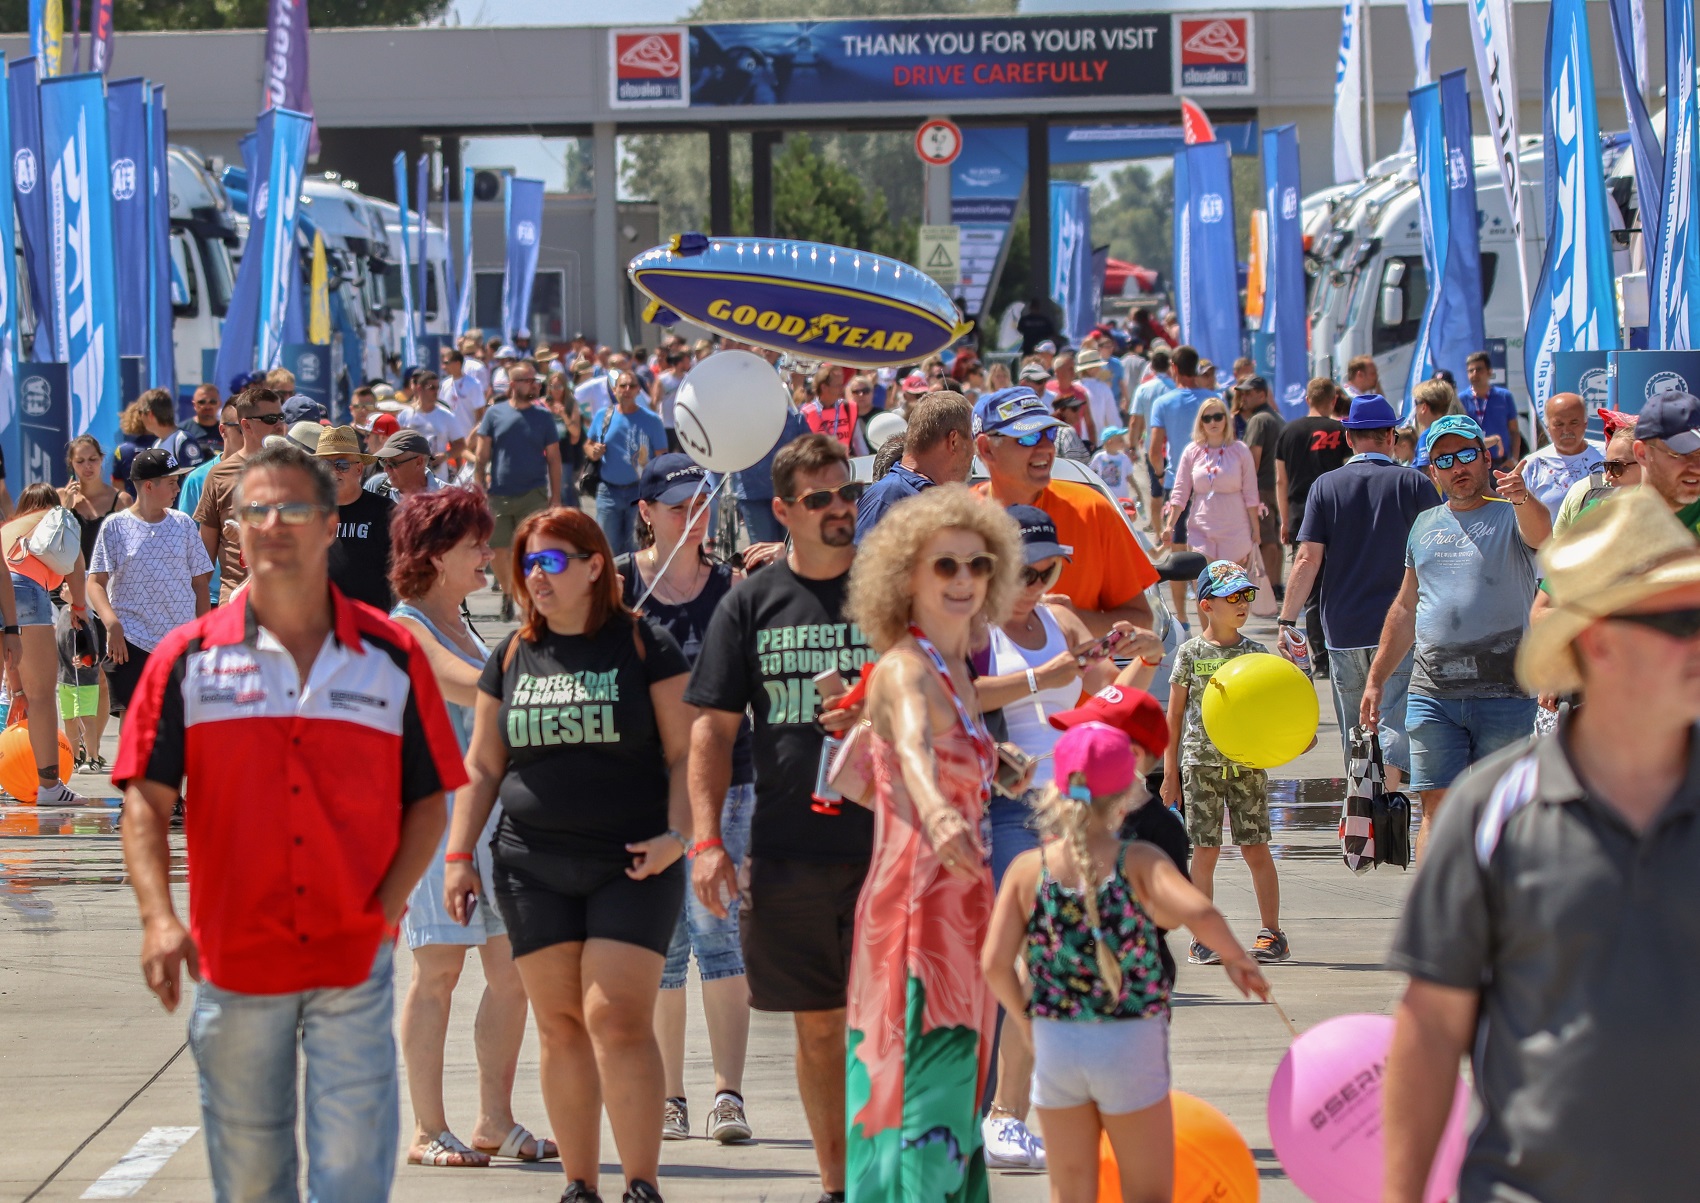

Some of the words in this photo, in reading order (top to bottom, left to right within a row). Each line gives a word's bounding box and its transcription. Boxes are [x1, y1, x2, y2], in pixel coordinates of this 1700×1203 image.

[842, 33, 921, 56] THANK
[924, 32, 974, 55] YOU
[981, 31, 1025, 53] FOR
[1030, 29, 1096, 52] YOUR
[1101, 28, 1157, 51] VISIT
[893, 65, 964, 87] DRIVE
[972, 61, 1108, 84] CAREFULLY
[27, 380, 45, 414] FIA
[1310, 430, 1341, 452] 24
[336, 522, 370, 539] TANG
[1420, 527, 1456, 549] True
[1455, 521, 1496, 548] Blue
[756, 623, 847, 653] PERFECT
[759, 652, 782, 676] TO
[782, 650, 837, 673] BURN
[839, 648, 880, 672] SOM
[516, 672, 584, 692] PERFECT
[584, 668, 619, 687] DAY
[512, 690, 526, 706] TO
[528, 689, 574, 705] BURN
[574, 684, 620, 702] SOME
[507, 704, 621, 748] DIESEL
